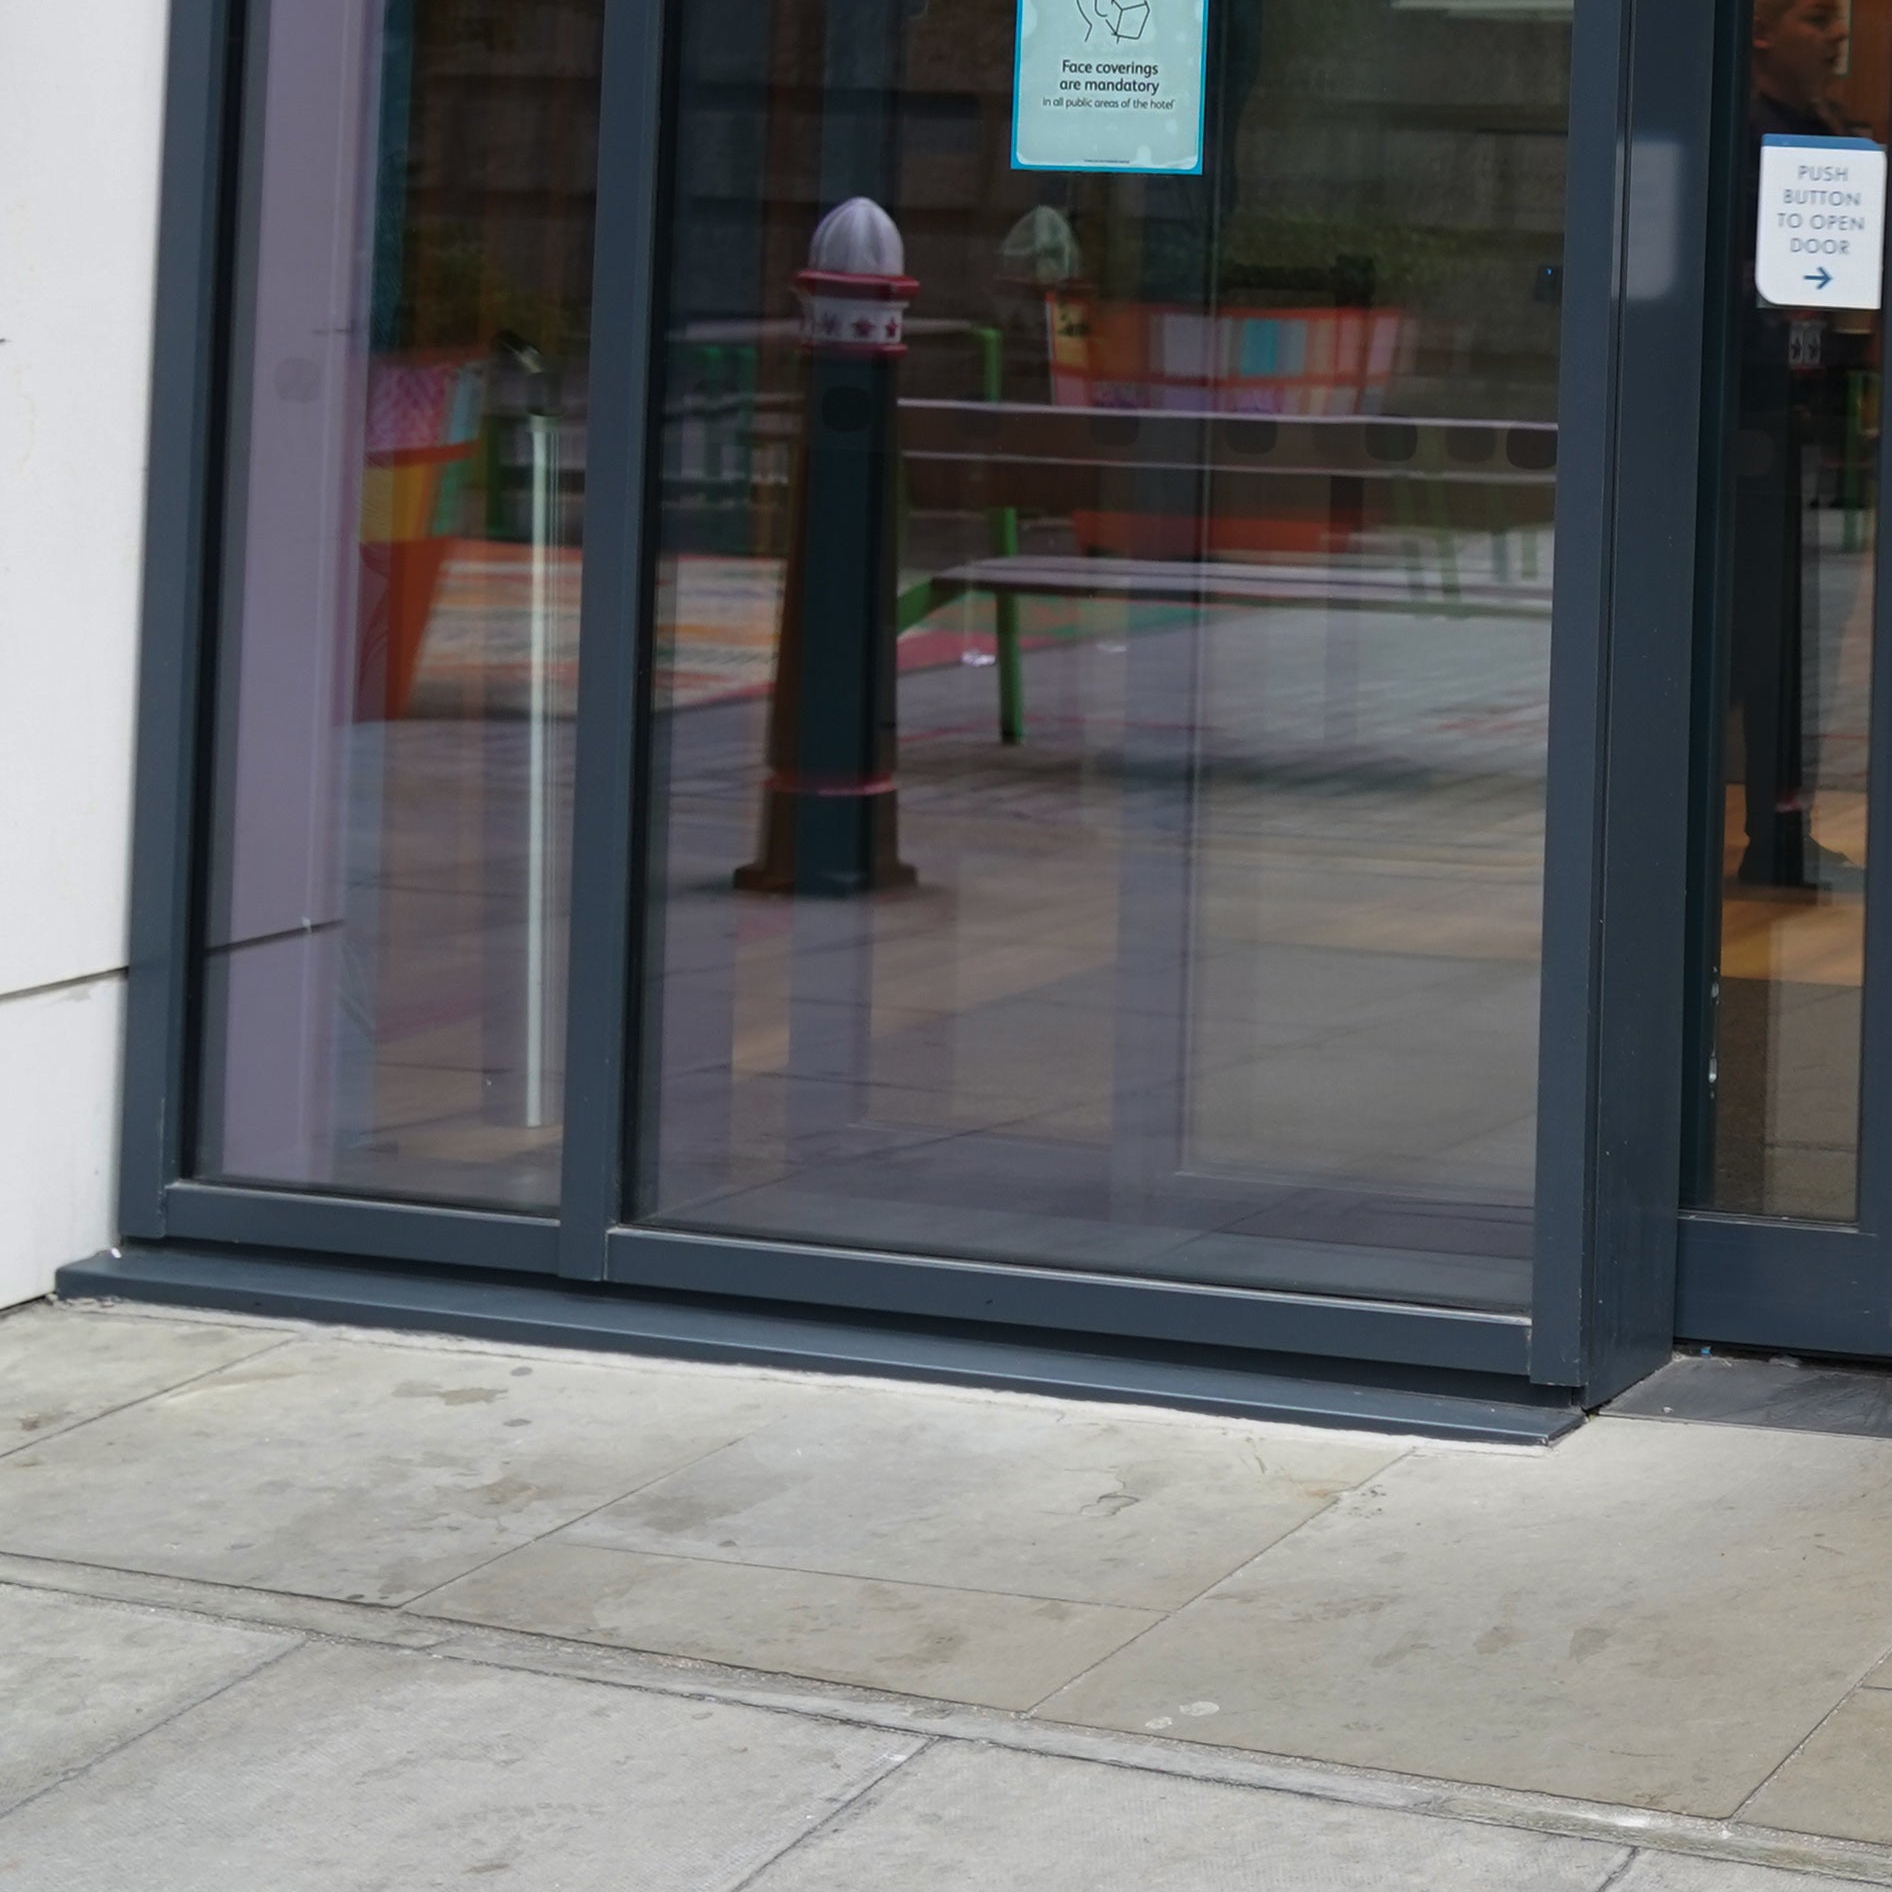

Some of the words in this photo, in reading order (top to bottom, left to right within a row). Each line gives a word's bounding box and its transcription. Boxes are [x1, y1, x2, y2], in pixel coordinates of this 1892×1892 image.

[1062, 60, 1093, 74] Face
[1096, 61, 1159, 78] coverings
[1059, 80, 1082, 91] are
[1085, 78, 1160, 96] mandatory
[1043, 97, 1051, 107] in
[1053, 97, 1064, 107] all
[1065, 97, 1092, 109] public
[1094, 100, 1119, 108] areas
[1121, 98, 1131, 108] of
[1133, 98, 1148, 109] the
[1150, 99, 1175, 109] hotel
[1798, 165, 1848, 181] PUSH
[1783, 189, 1862, 206] BUTTON
[1777, 213, 1803, 228] TO
[1809, 214, 1865, 230] OPEN
[1790, 237, 1850, 254] DOOR
